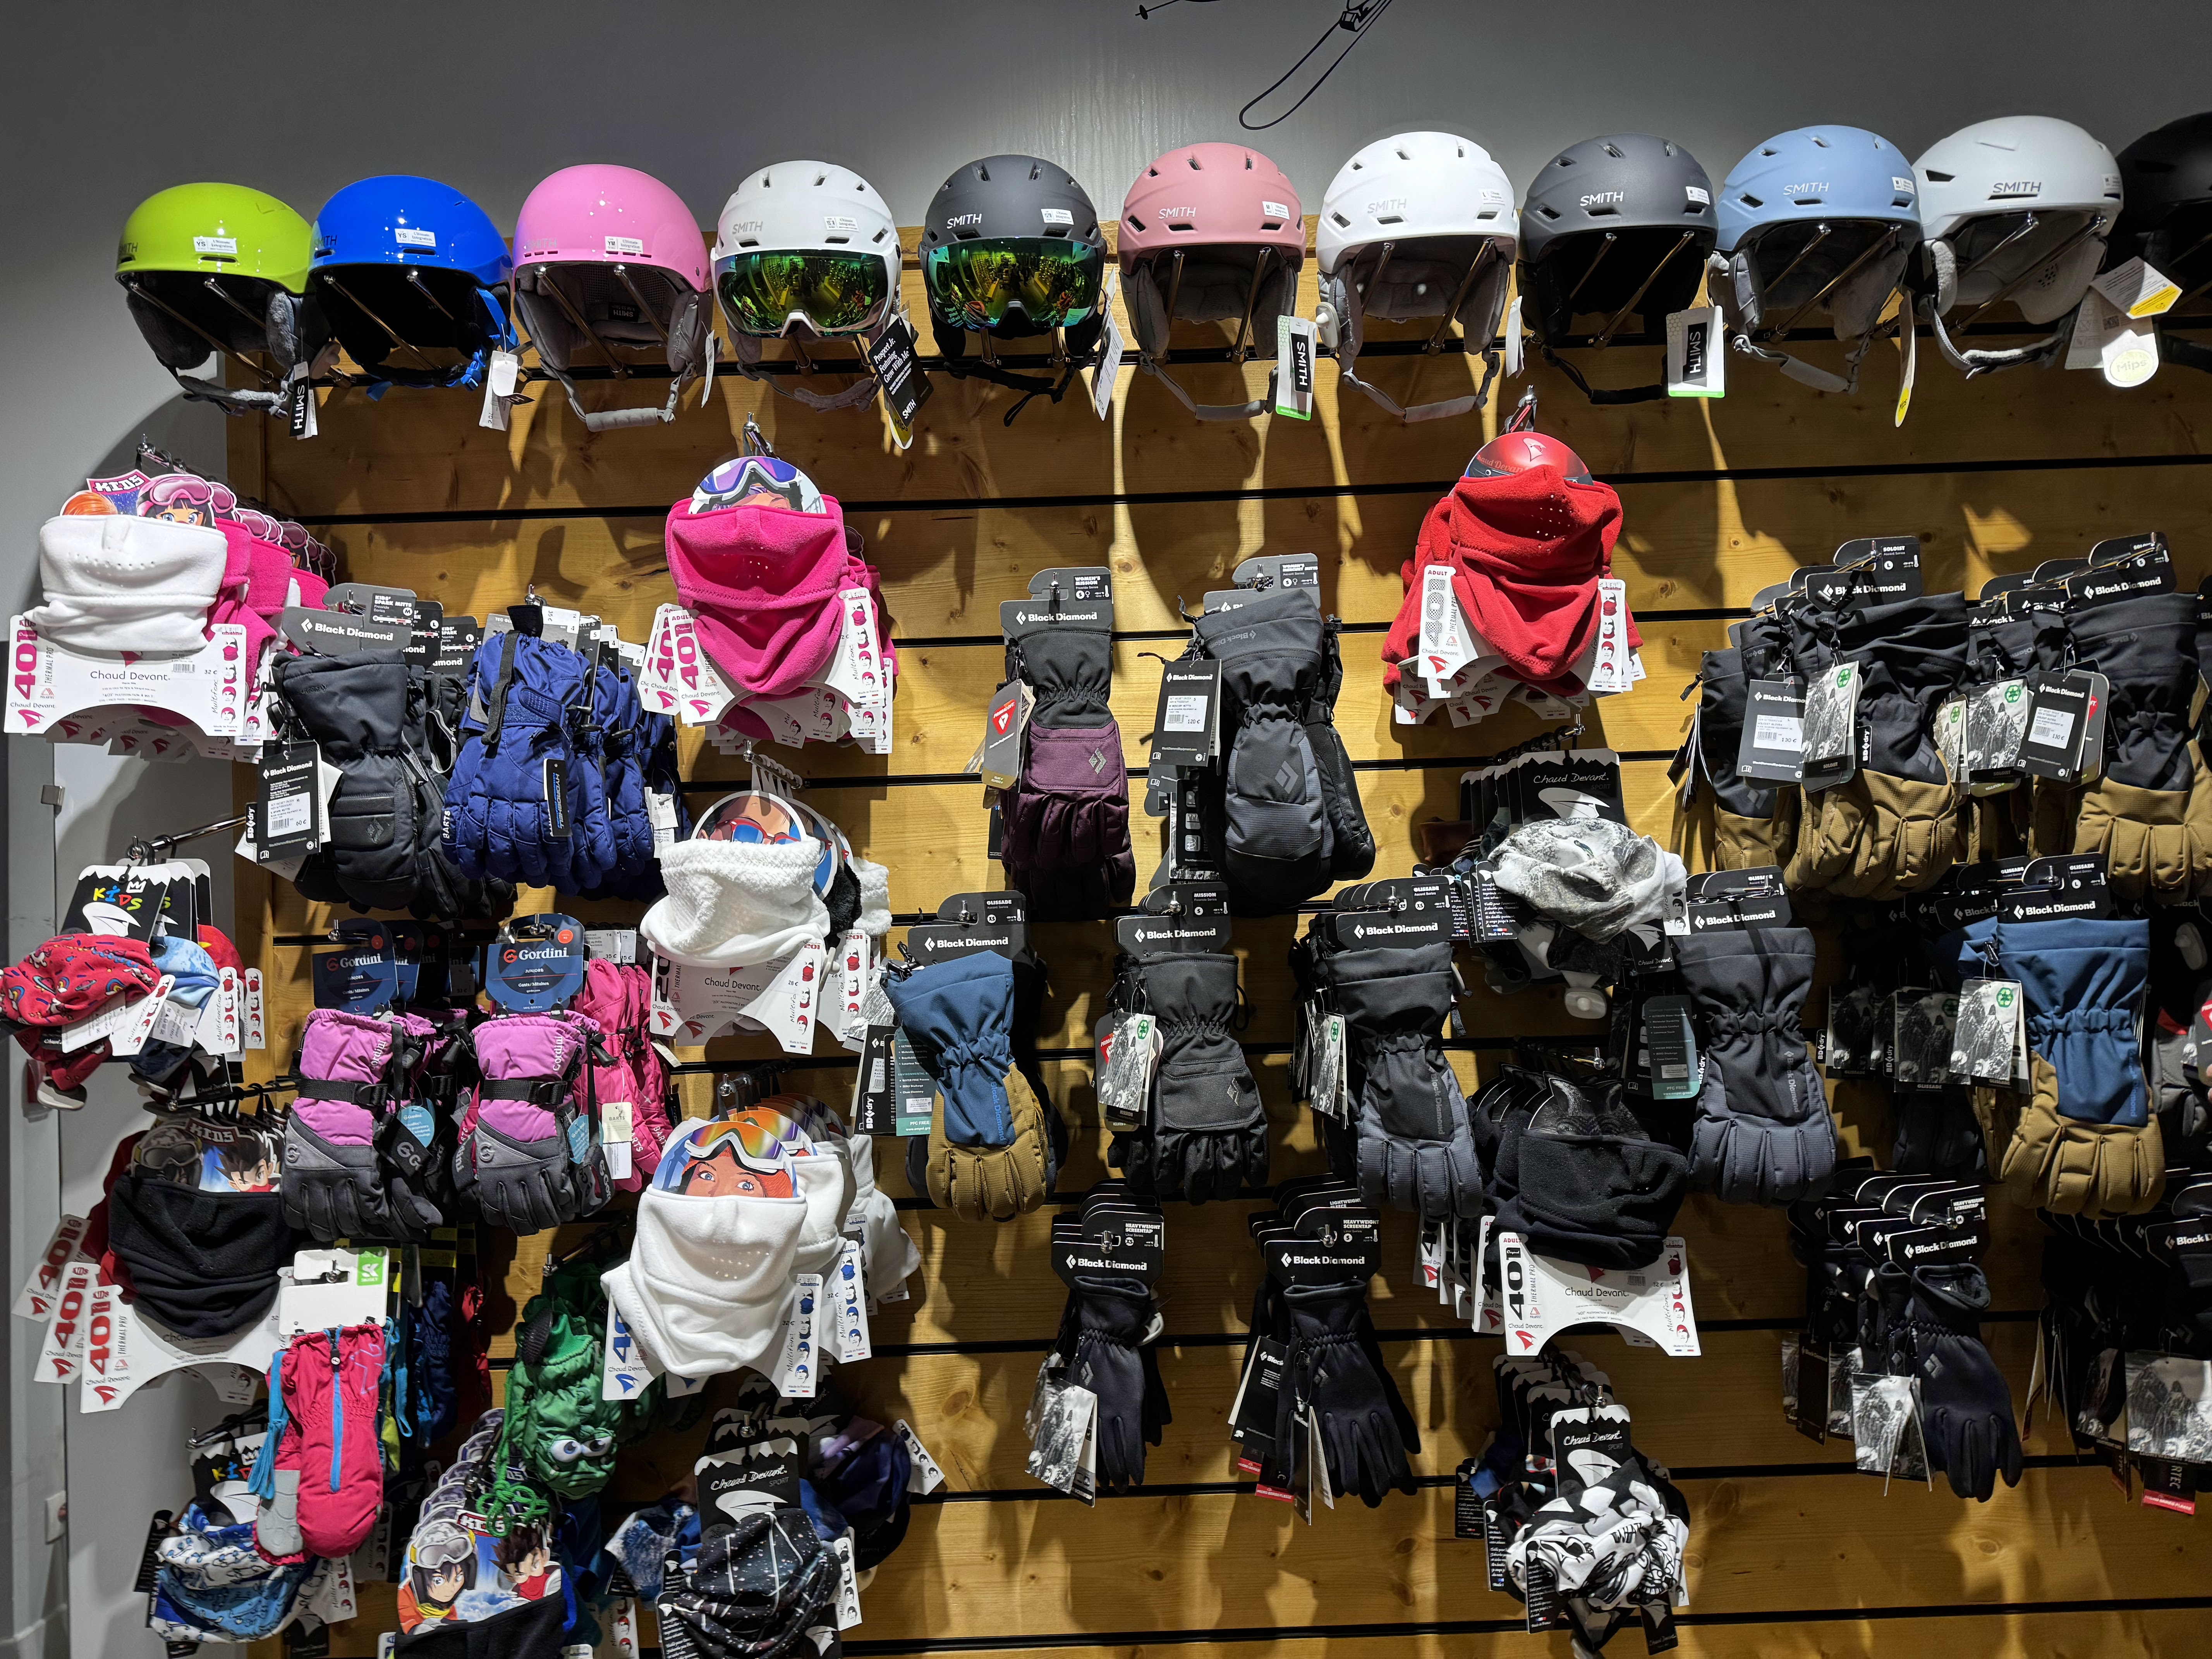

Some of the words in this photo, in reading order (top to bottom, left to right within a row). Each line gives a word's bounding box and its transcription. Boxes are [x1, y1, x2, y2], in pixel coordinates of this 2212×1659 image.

[1783, 182, 1829, 196] SMITH
[1993, 181, 2042, 193] SMITH
[1367, 198, 1407, 214] SMITH
[1580, 191, 1624, 206] SMITH
[946, 213, 982, 229] SMITH
[1158, 207, 1196, 220] SMITH
[732, 221, 763, 235] SMITH
[314, 235, 337, 246] SMITH
[525, 239, 557, 251] SMITH
[874, 342, 890, 364] Prospect
[1689, 331, 1702, 374] SMITH
[878, 350, 898, 375] Featuring
[883, 368, 896, 383] Grow
[893, 358, 904, 375] With
[1297, 341, 1308, 386] SMITH
[2116, 358, 2147, 373] Mips
[294, 385, 305, 429] SMITH
[902, 399, 917, 419] SMITH
[94, 475, 145, 494] KIDS
[1864, 583, 1906, 593] Diamond
[2095, 583, 2121, 596] Black
[2122, 576, 2162, 592] Diamond
[1028, 613, 1054, 622] Black
[1056, 611, 1097, 621] Diamond
[1425, 579, 1446, 647] 401
[314, 622, 346, 634] Black
[347, 625, 393, 641] Diamond
[676, 624, 696, 691] 401
[15, 631, 38, 701] 401
[90, 670, 126, 680] Chaud
[130, 671, 171, 681] Devant.
[2045, 686, 2059, 694] Black
[2060, 689, 2085, 698] Diamond
[270, 766, 286, 776] Black
[287, 761, 313, 773] Diamond
[1533, 774, 1569, 784] Chaud
[555, 773, 565, 830] HYDROSHELL
[93, 885, 143, 911] KIDS
[1964, 907, 1989, 917] Black
[2025, 904, 2052, 916] Black
[2053, 900, 2096, 913] Diamond
[1706, 916, 1733, 925] Black
[1734, 910, 1776, 921] Diamond
[1147, 930, 1173, 939] Black
[1175, 928, 1216, 938] Diamond
[1366, 925, 1394, 936] Black
[1395, 923, 1438, 933] Diamond
[936, 938, 964, 948] Black
[965, 936, 1008, 947] Diamond
[339, 953, 383, 969] Gordini
[518, 947, 569, 960] Gordini
[704, 977, 729, 988] Chaud
[732, 980, 762, 991] Devant.
[552, 1035, 563, 1072] Gordini
[1785, 1057, 1794, 1079] Black
[990, 1081, 1000, 1110] Black
[1788, 1079, 1800, 1113] Diamond
[1434, 1097, 1445, 1135] Diamond
[189, 1123, 235, 1142] KIDS
[992, 1111, 1004, 1142] Diamond
[1953, 1197, 1985, 1207] HEAVYWEIGHT
[1915, 1243, 1939, 1255] Black
[1940, 1235, 1978, 1250] Diamond
[2176, 1234, 2205, 1246] Black
[1077, 1258, 1104, 1268] Black
[1105, 1261, 1147, 1272] Diamond
[1293, 1256, 1321, 1265] Black
[1322, 1256, 1365, 1265] Diamond
[1507, 1247, 1525, 1321] 401
[1565, 1287, 1594, 1297] Chaud
[1596, 1288, 1629, 1298] Devant.
[89, 1300, 111, 1376] 401
